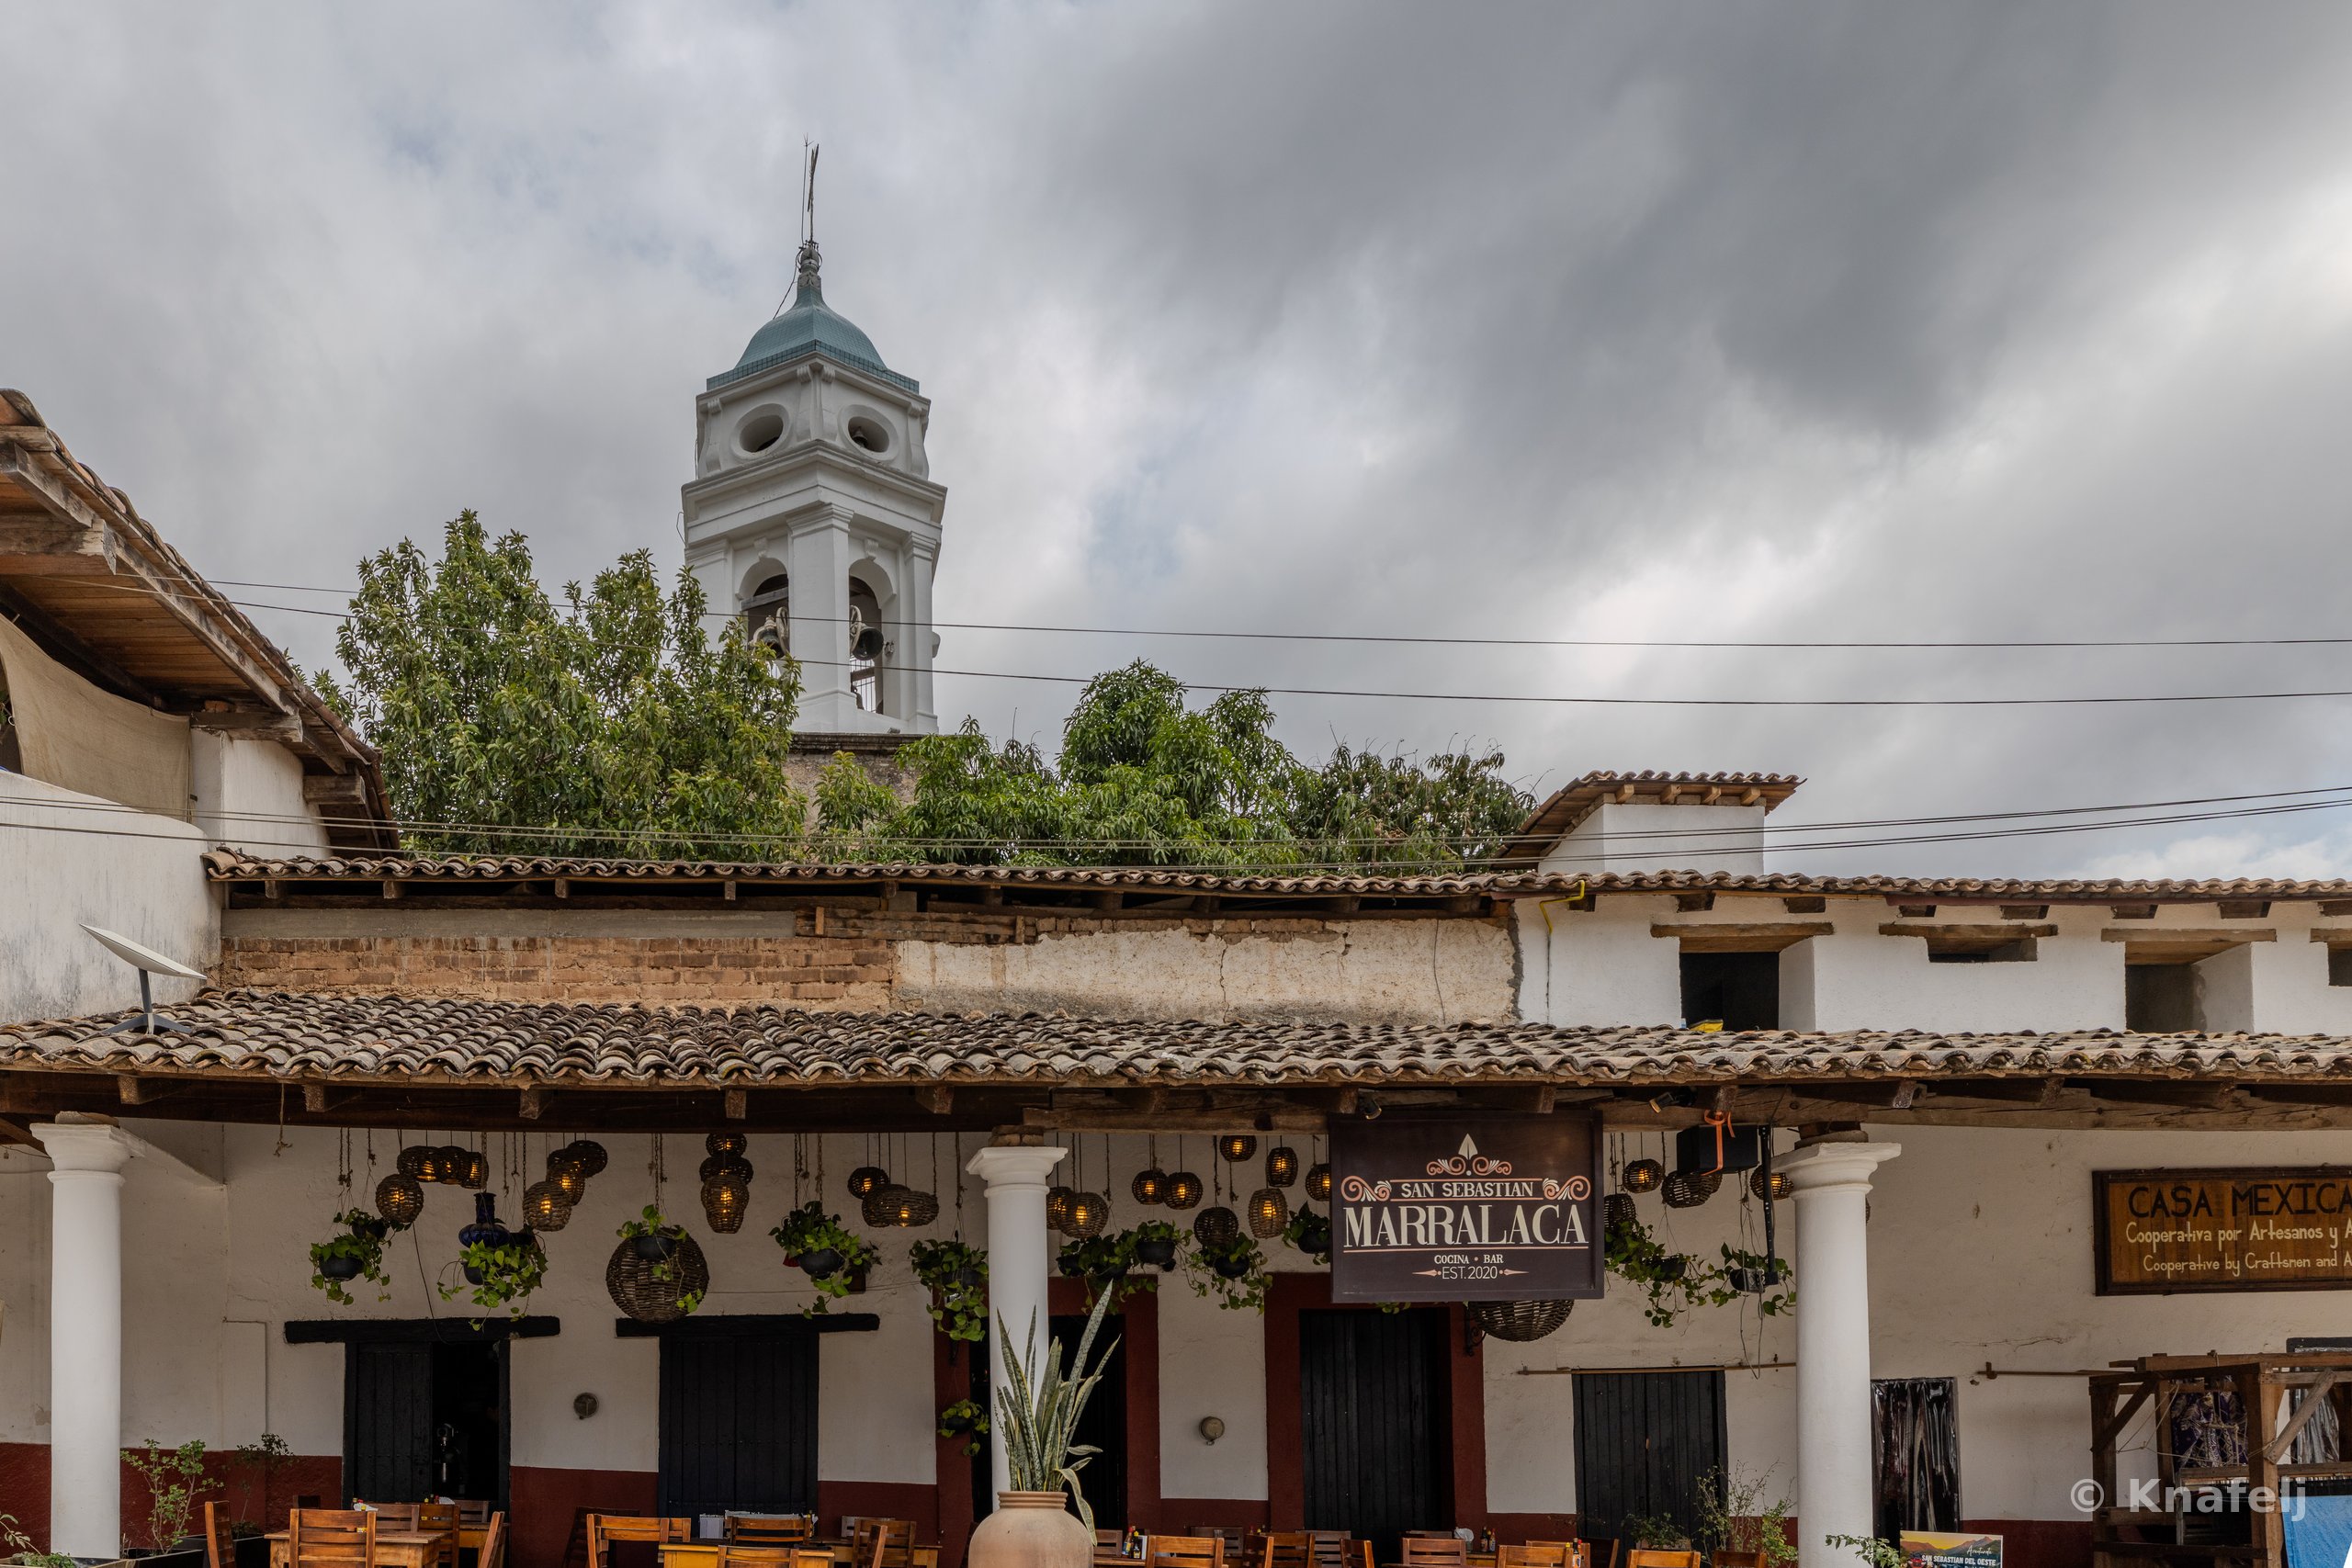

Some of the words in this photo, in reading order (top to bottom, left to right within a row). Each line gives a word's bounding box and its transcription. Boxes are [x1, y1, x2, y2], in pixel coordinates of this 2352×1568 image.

[1401, 1182, 1434, 1198] SAN
[1442, 1181, 1533, 1198] SEBASTIAN
[2128, 1186, 2213, 1218] CASA
[2231, 1182, 2352, 1217] MEXICA
[1343, 1204, 1589, 1247] MARRALACA
[2125, 1221, 2212, 1253] Cooperativa
[2217, 1227, 2243, 1251] por
[2249, 1219, 2324, 1242] Artesanos
[2329, 1224, 2338, 1249] y
[1434, 1254, 1470, 1265] COCINA
[1483, 1254, 1504, 1264] BAR
[2143, 1254, 2220, 1279] Cooperative
[2225, 1254, 2240, 1277] by
[2245, 1251, 2311, 1271] Craftsmen
[2315, 1250, 2337, 1268] and
[1933, 1556, 1964, 1564] SEBASTIAN
[1964, 1557, 1976, 1565] DEL
[1977, 1558, 1996, 1566] OESTE
